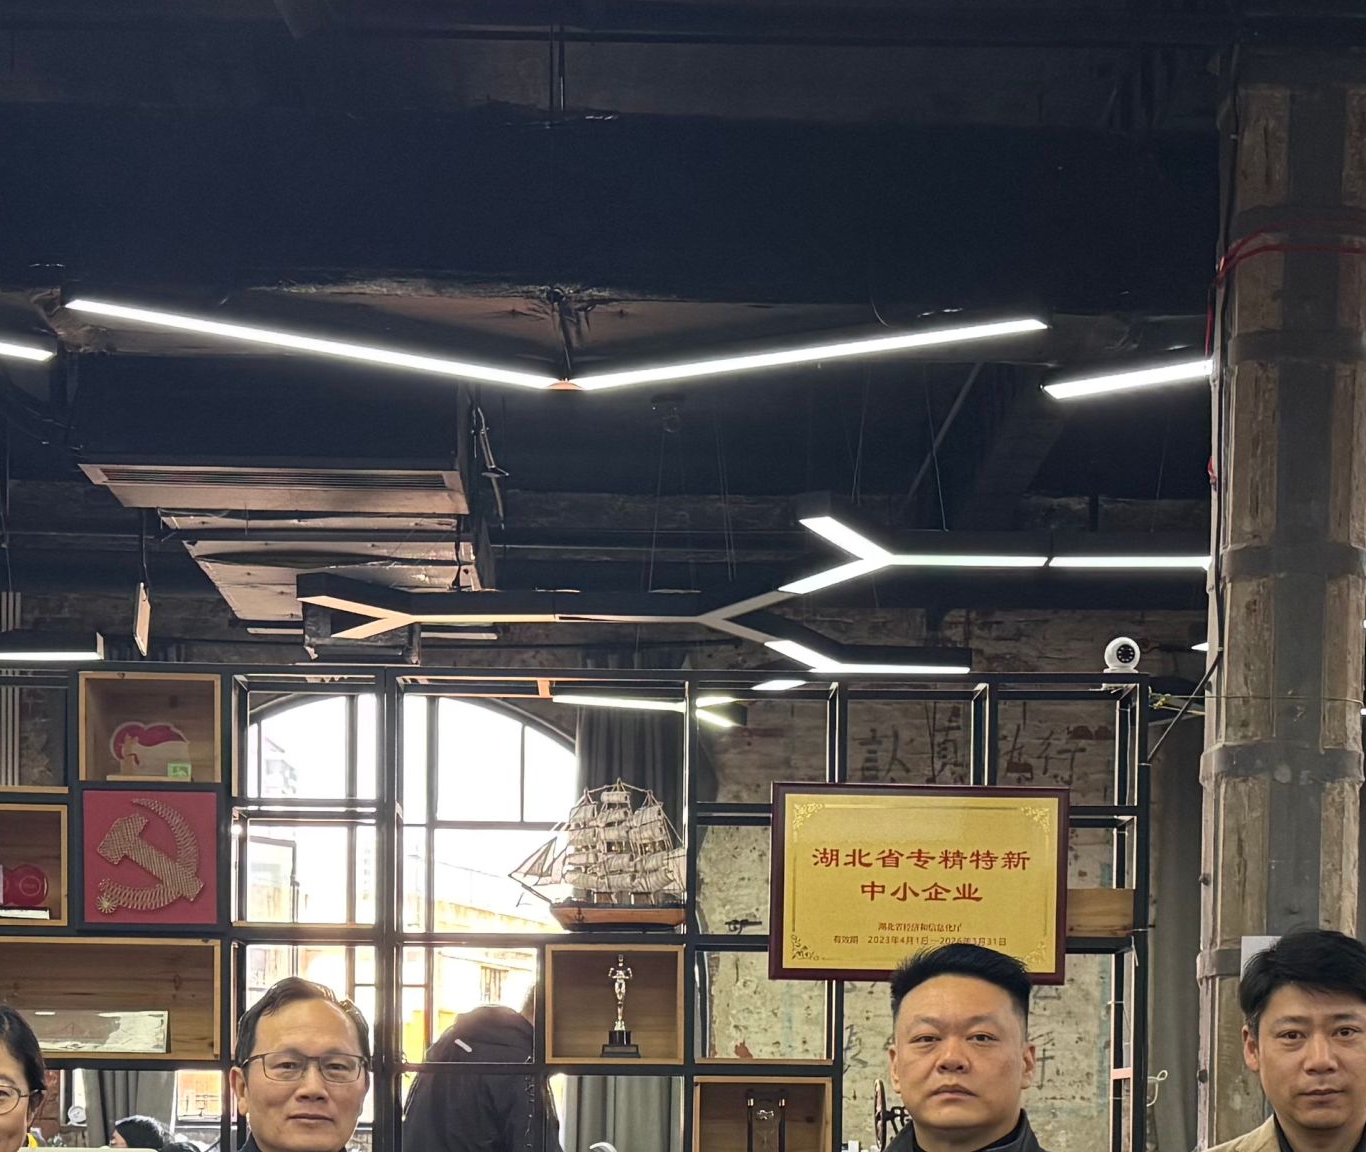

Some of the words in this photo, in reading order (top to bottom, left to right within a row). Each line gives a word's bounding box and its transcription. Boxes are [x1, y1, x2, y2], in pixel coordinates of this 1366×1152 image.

[811, 847, 1031, 871] 湖北省专精特新
[860, 880, 984, 902] 中小企业
[833, 935, 859, 944] 有效期
